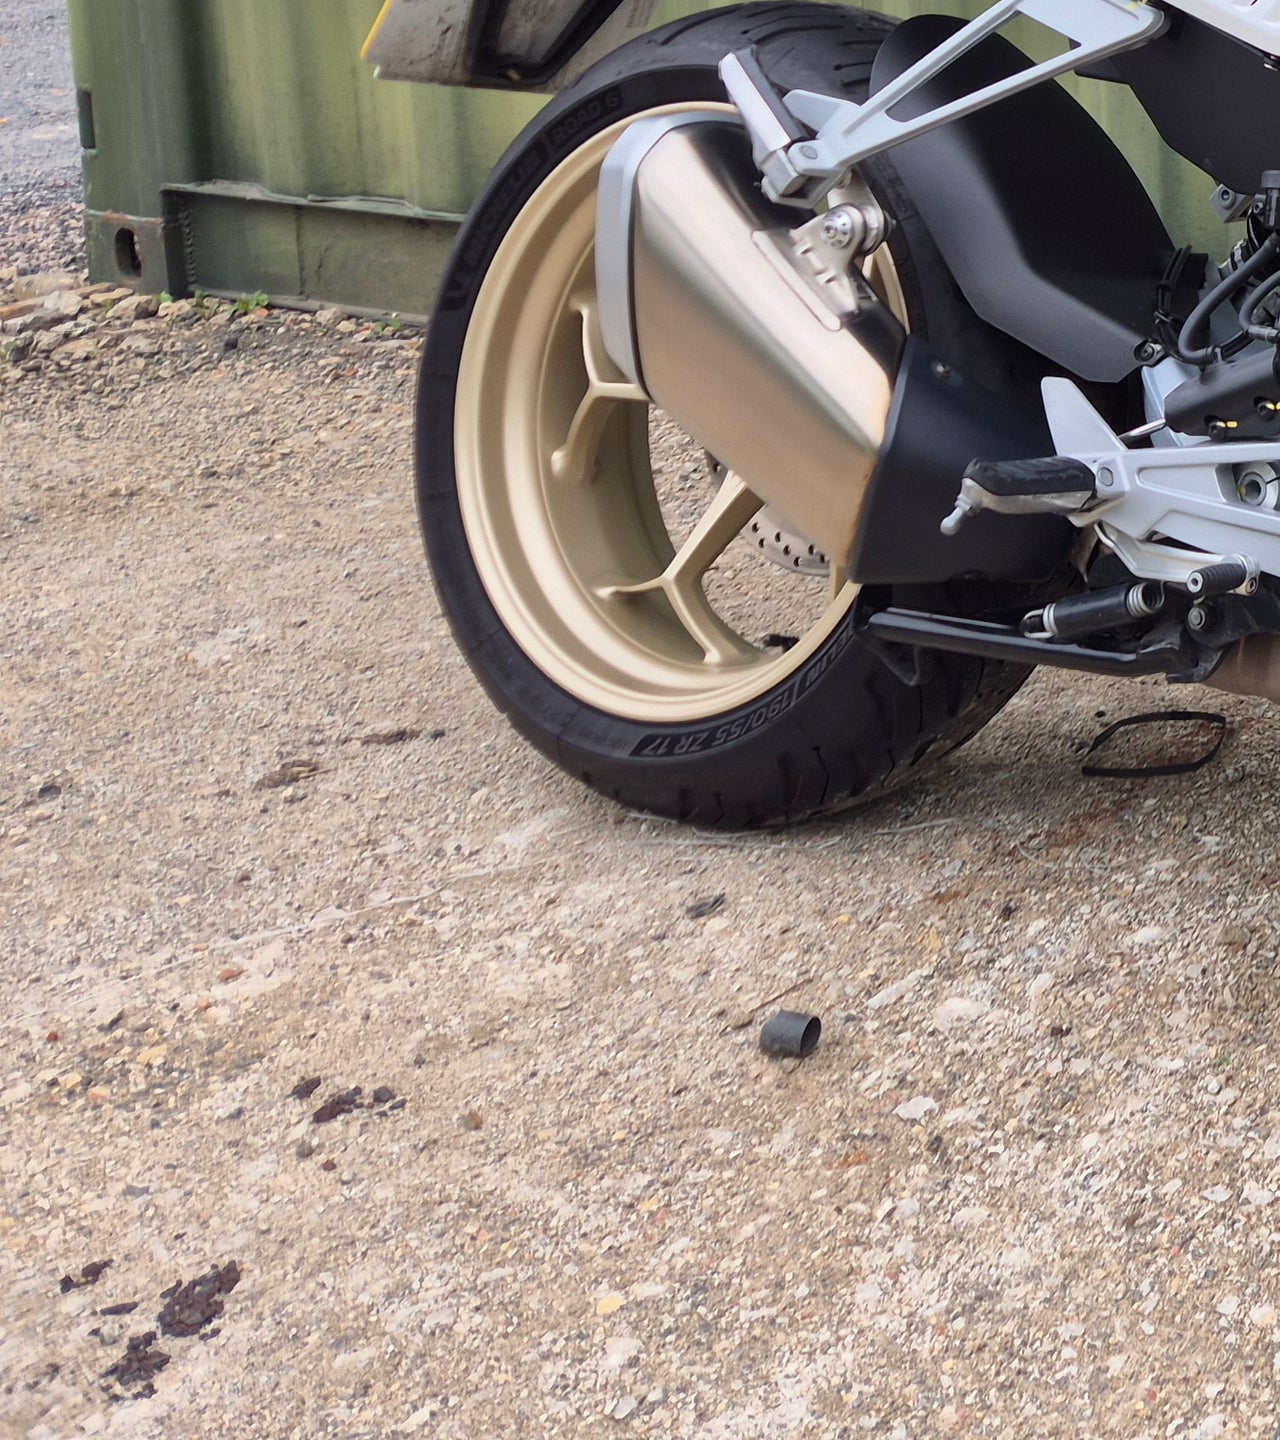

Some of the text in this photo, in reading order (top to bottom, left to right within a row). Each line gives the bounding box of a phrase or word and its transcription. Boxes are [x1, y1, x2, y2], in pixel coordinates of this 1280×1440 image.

[553, 101, 602, 146] ROAD
[715, 689, 793, 746] 190/55
[640, 735, 671, 756] 17
[673, 737, 709, 756] ZR
